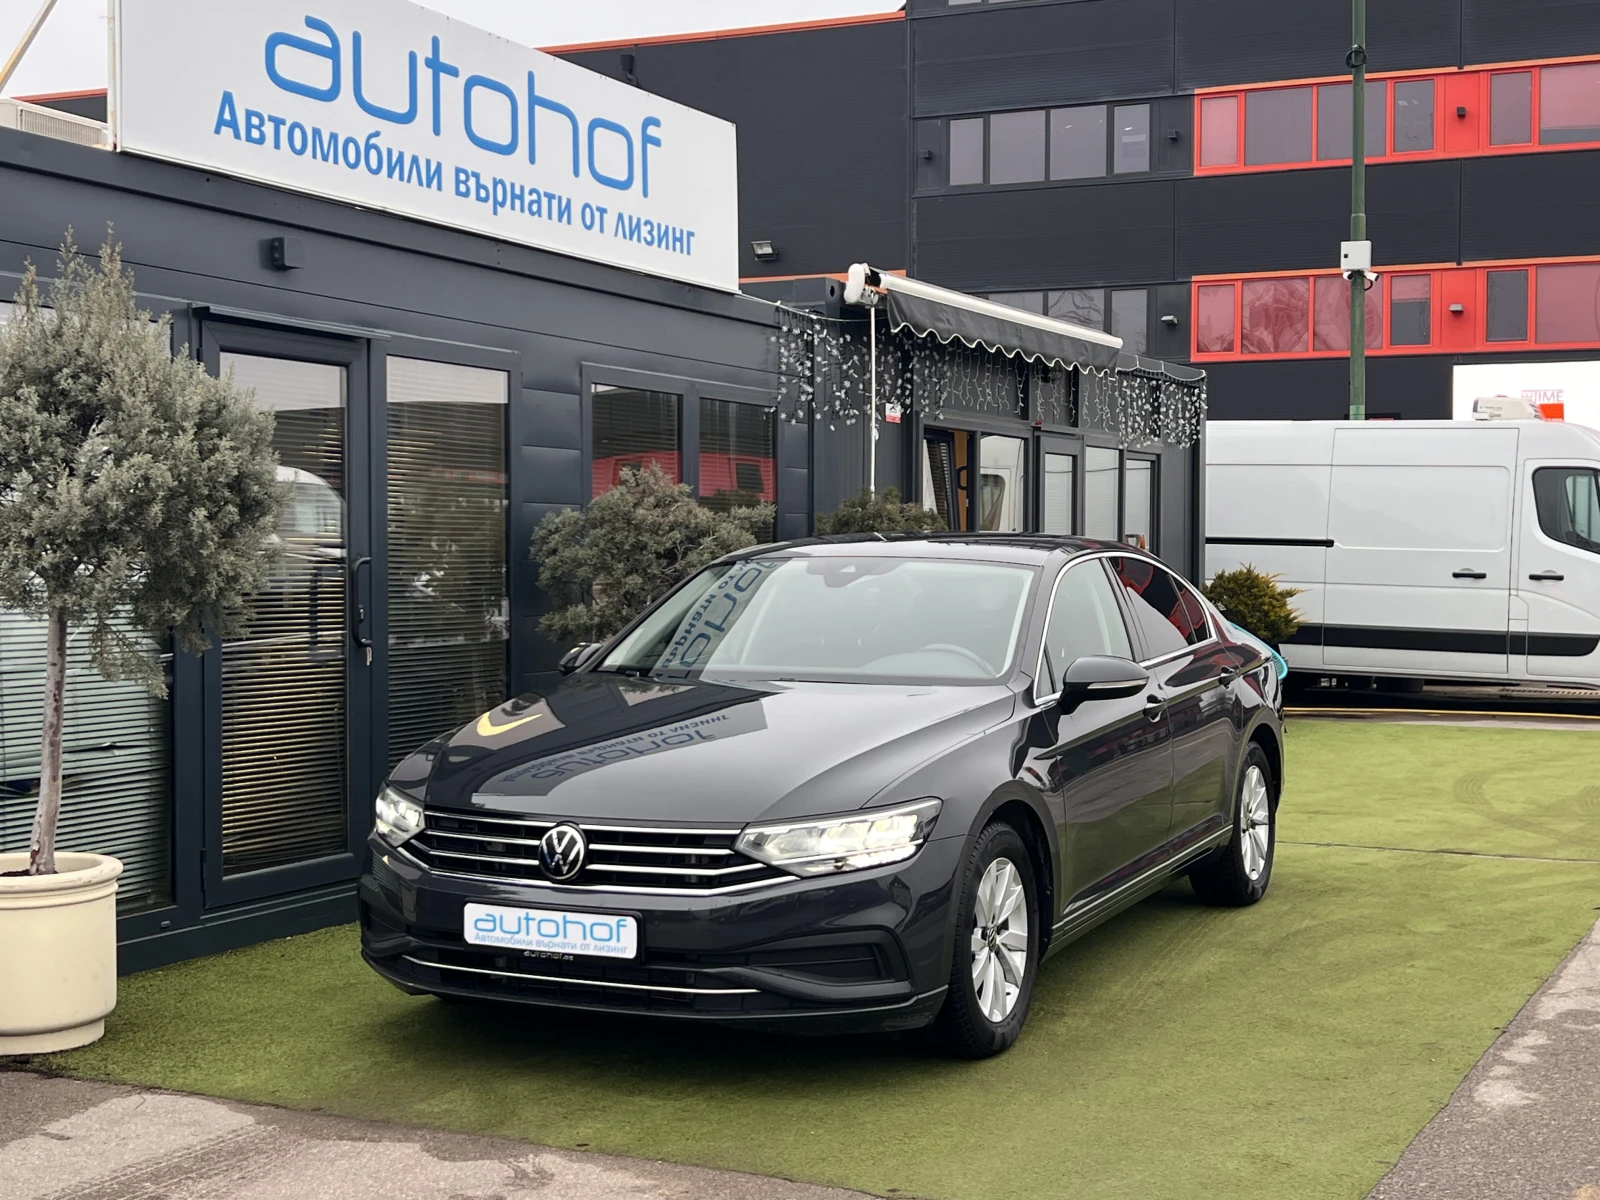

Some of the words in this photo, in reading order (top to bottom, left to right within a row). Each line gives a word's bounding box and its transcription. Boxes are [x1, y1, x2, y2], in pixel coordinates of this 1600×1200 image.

[264, 14, 662, 199] autohof
[213, 90, 443, 192] Автомобили
[454, 165, 572, 226] върнати
[581, 202, 608, 234] от
[614, 211, 695, 256] лизинг
[474, 912, 627, 943] autohof
[474, 932, 533, 947] Автомобили
[536, 939, 577, 951] върнати
[580, 943, 590, 951] от
[593, 944, 628, 954] лизинг
